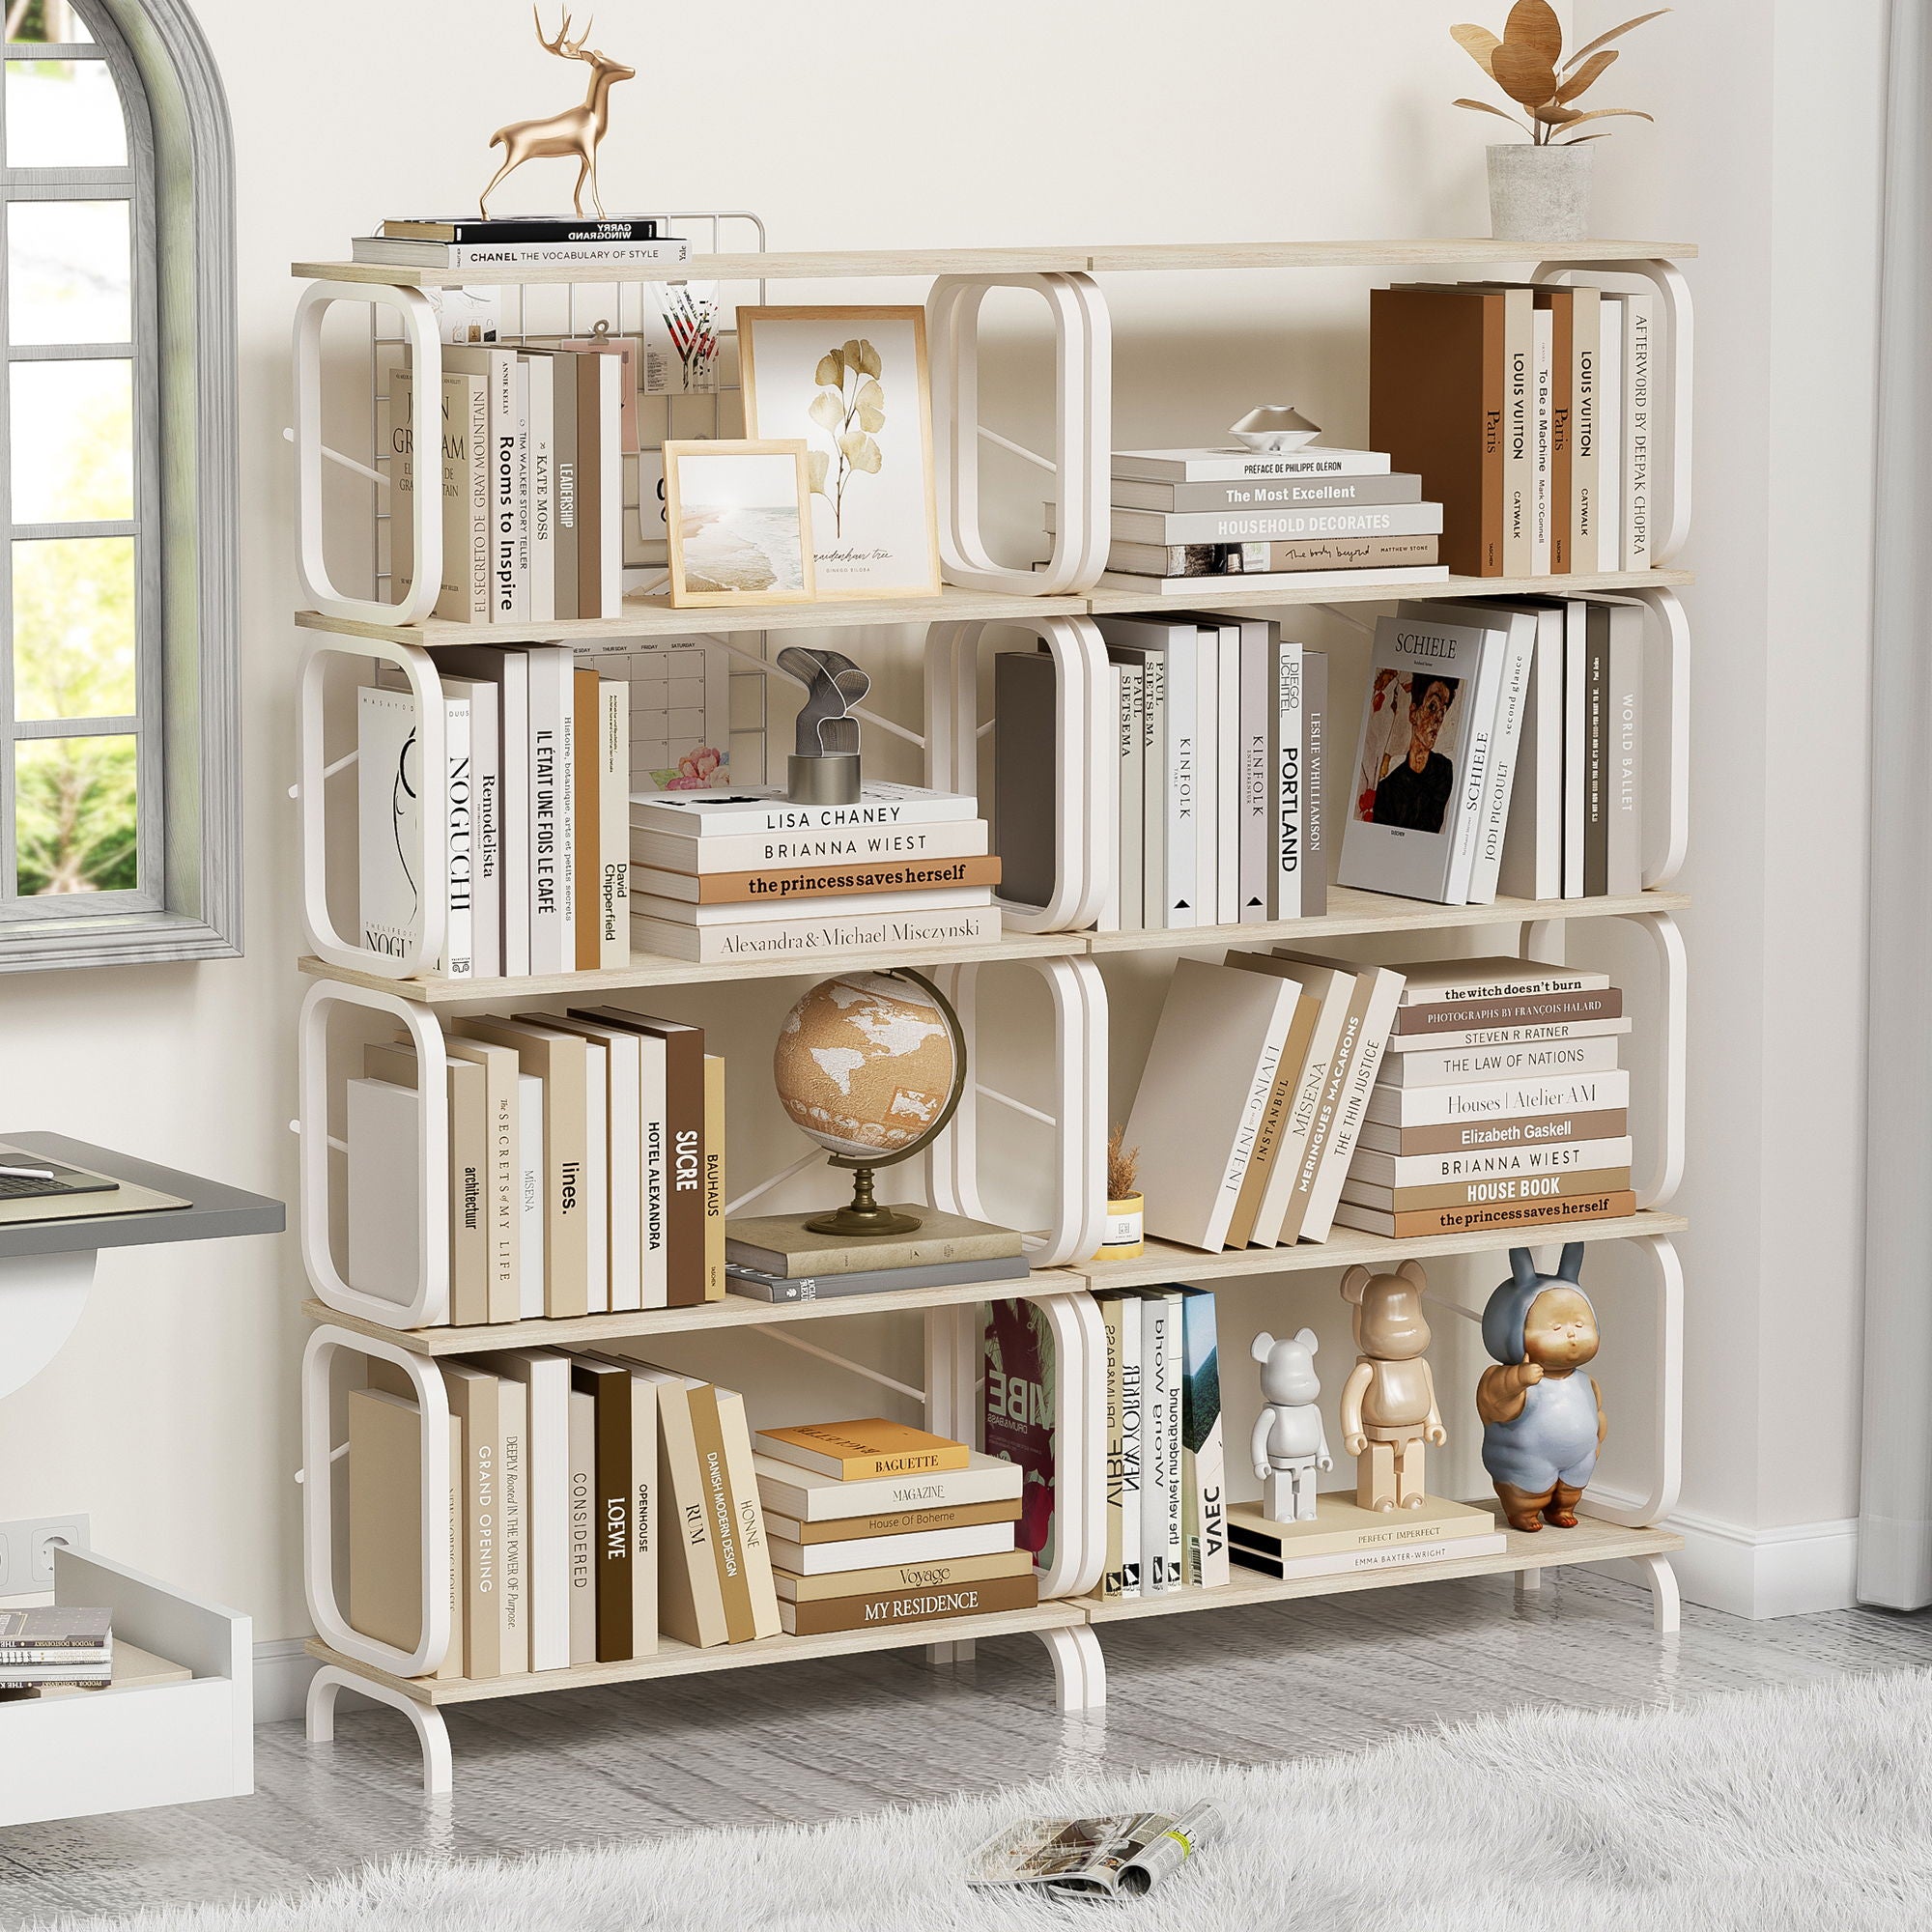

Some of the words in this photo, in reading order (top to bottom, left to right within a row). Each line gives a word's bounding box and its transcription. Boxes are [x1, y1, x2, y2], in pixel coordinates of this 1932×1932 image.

[470, 252, 518, 262] CHANEL
[520, 251, 540, 261] THE
[542, 250, 611, 260] VOCABULARY
[612, 250, 626, 259] OF
[628, 249, 659, 259] STYLE
[678, 245, 687, 261] Yale
[1514, 354, 1524, 395] LOUIS
[1580, 352, 1592, 393] LOUIS
[1635, 315, 1647, 408] AFTERWORD
[473, 390, 485, 469] MOUNTAIN
[1487, 410, 1500, 454] Paris
[1513, 400, 1524, 460] VUITTON
[1554, 408, 1569, 452] Paris
[1580, 397, 1592, 458] VUITTON
[1634, 412, 1646, 431] BY
[499, 436, 515, 506] Rooms
[536, 454, 548, 496] KATE
[1634, 436, 1647, 492] DEEPAK
[474, 470, 486, 508] GRAY
[559, 463, 574, 528] LEADERSHIP
[1226, 490, 1251, 502] The
[1254, 488, 1289, 501] Most
[1293, 485, 1355, 500] Excellent
[474, 515, 486, 533] DE
[499, 511, 514, 533] to
[536, 500, 548, 541] MOSS
[1218, 518, 1305, 535] HOUSEHOLD
[1309, 514, 1390, 531] DECORATES
[1513, 491, 1521, 539] CATWALK
[1580, 488, 1589, 536] CATWALK
[1634, 496, 1645, 555] CHOPRA
[474, 536, 486, 598] SECRETO
[520, 535, 528, 570] TELLER
[497, 540, 517, 611] Inspire
[474, 601, 486, 612] EL
[1395, 633, 1458, 660] SCHIELE
[1134, 675, 1143, 718] PAUL
[1155, 662, 1164, 706] PAUL
[1281, 655, 1290, 718] UCHITEL
[1290, 662, 1299, 709] DIEGO
[1505, 696, 1517, 735] second
[1512, 655, 1523, 693] glance
[537, 730, 553, 743] IL
[1122, 676, 1130, 757] SIETSEMA
[1311, 712, 1321, 753] LESLIE
[1622, 694, 1634, 751] WORLD
[537, 748, 554, 786] ÉTAIT
[1179, 738, 1190, 819] KINFOLK
[1253, 735, 1264, 816] KINFOLK
[1466, 732, 1489, 811] SCHIELE
[1622, 757, 1633, 811] BALLET
[537, 790, 554, 818] UNE
[1282, 748, 1298, 872] PORTLAND
[1310, 756, 1321, 851] WHILLIAMSON
[1491, 761, 1509, 824] PICOULT
[449, 756, 470, 912] NOGUCHI
[483, 774, 497, 879] Remodelista
[537, 823, 554, 854] FOIS
[767, 812, 810, 829] LISA
[821, 807, 900, 826] CHANEY
[538, 858, 554, 873] LE
[764, 840, 856, 859] BRIANNA
[867, 835, 926, 851] WIEST
[1485, 828, 1498, 862] JODI
[538, 878, 556, 914] CAFÉ
[617, 864, 627, 898] David
[749, 876, 778, 894] the
[780, 872, 855, 896] princess
[856, 869, 903, 887] saves
[905, 865, 966, 884] herself
[605, 865, 616, 941] Chipperfield
[721, 931, 804, 954] Alexandra
[806, 934, 820, 949] &
[821, 924, 886, 947] Michael
[893, 919, 980, 944] Misczynski
[1445, 989, 1466, 1000] the
[1467, 986, 1502, 998] witch
[1552, 980, 1582, 991] burn
[1428, 1009, 1499, 1024] PHOTOGRAPHS
[1501, 1007, 1513, 1017] BY
[1515, 1003, 1561, 1017] FRANÇOIS
[1563, 1000, 1602, 1012] HALARD
[1464, 1031, 1509, 1044] STEVEN
[1513, 1030, 1520, 1040] R
[1524, 1026, 1569, 1038] RATNER
[1443, 1059, 1469, 1072] THE
[1475, 1056, 1502, 1070] LAW
[1506, 1054, 1522, 1067] OF
[1528, 1049, 1584, 1065] NATIONS
[1298, 1105, 1332, 1192] MERINGUES
[1326, 1015, 1359, 1100] MACARONS
[1334, 1132, 1352, 1156] THE
[1344, 1095, 1361, 1129] THIN
[1354, 1039, 1379, 1094] JUSTICE
[1448, 1095, 1500, 1114] Houses
[1513, 1087, 1564, 1108] Atelier
[1566, 1084, 1596, 1103] AM
[1257, 1079, 1289, 1162] INSTANBUL
[1462, 1124, 1520, 1145] Elizabeth
[1523, 1121, 1573, 1138] Gaskell
[648, 1122, 660, 1166] HOTEL
[675, 1130, 698, 1191] SUCRE
[1441, 1155, 1520, 1176] BRIANNA
[1530, 1150, 1580, 1166] WIEST
[465, 1167, 480, 1230] architectuur
[562, 1161, 580, 1214] lines.
[707, 1154, 719, 1217] BAUHAUS
[1467, 1180, 1516, 1203] HOUSE
[1520, 1177, 1561, 1197] BOOK
[648, 1168, 661, 1250] ALEXANDRA
[1440, 1212, 1463, 1226] the
[1464, 1208, 1522, 1228] princess
[1523, 1205, 1561, 1217] saves
[1562, 1199, 1609, 1214] herself
[479, 1445, 491, 1506] GRAND
[707, 1452, 723, 1494] DANISH
[875, 1455, 939, 1473] BAGUETTE
[893, 1485, 945, 1502] MAGAZINE
[573, 1472, 587, 1589] CONSIDERED
[608, 1497, 626, 1560] LOEWE
[639, 1484, 648, 1552] OPENHOUSE
[686, 1503, 706, 1546] RUM
[713, 1493, 731, 1538] MODERN
[740, 1500, 760, 1548] HONNE
[868, 1518, 899, 1530] House
[901, 1515, 915, 1526] Of
[917, 1512, 955, 1524] Boheme
[1357, 1532, 1393, 1545] PERFECT
[1396, 1527, 1441, 1540] IMPERFECT
[479, 1514, 492, 1593] OPENING
[722, 1538, 737, 1577] DESIGN
[1354, 1557, 1378, 1567] EMMA
[1381, 1548, 1446, 1563] BAXTER-WRIGHT
[899, 1566, 952, 1587] Voyage
[865, 1602, 891, 1621] MY
[892, 1591, 979, 1618] RESIDENCE
